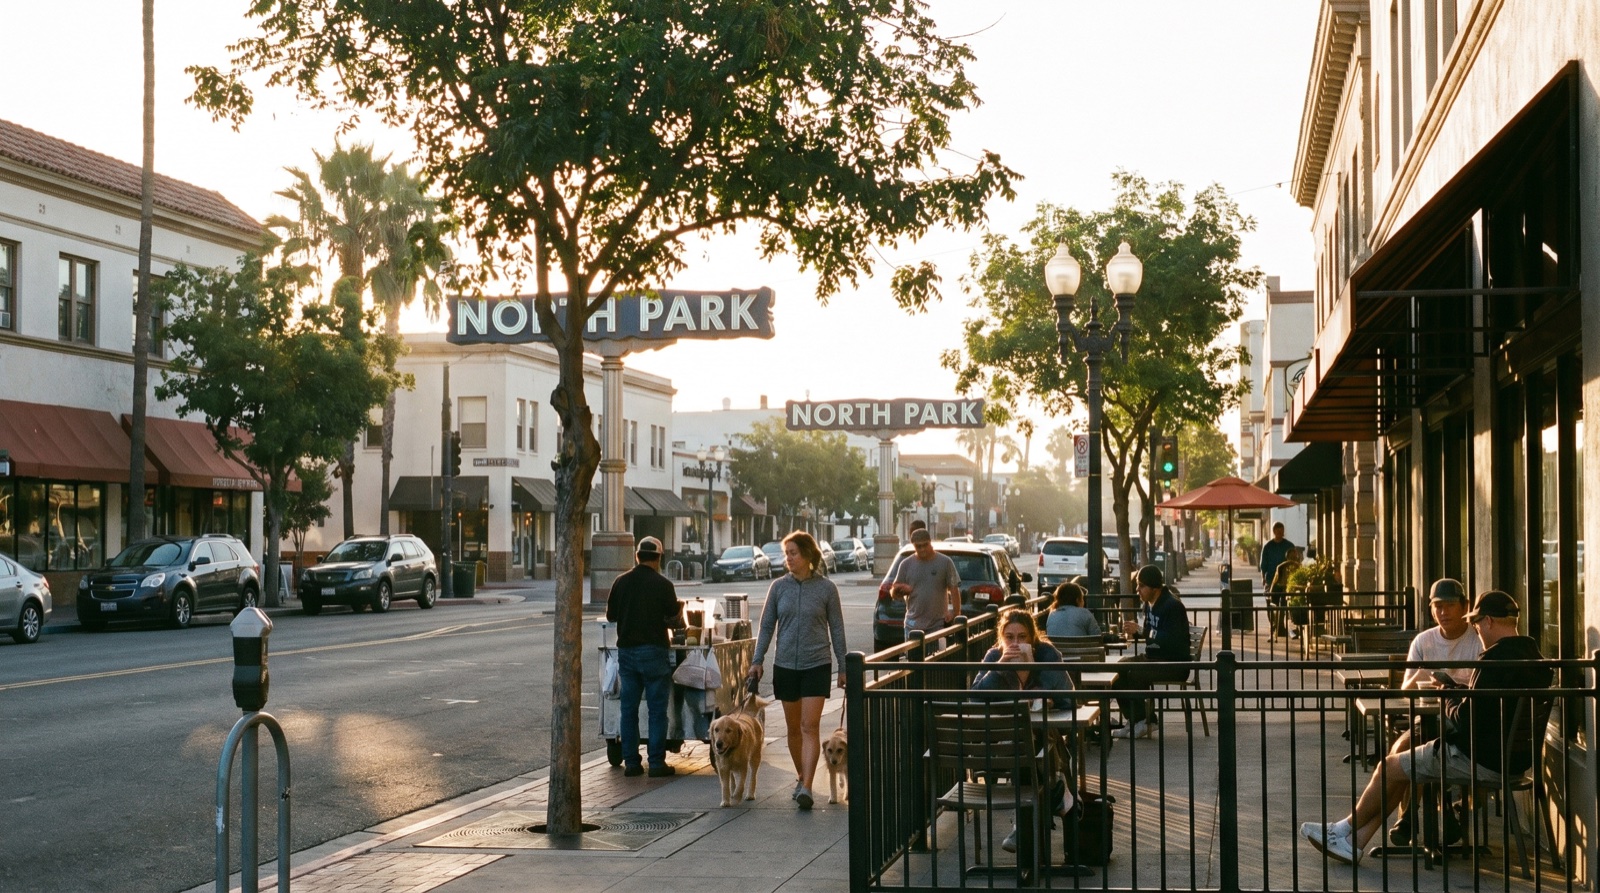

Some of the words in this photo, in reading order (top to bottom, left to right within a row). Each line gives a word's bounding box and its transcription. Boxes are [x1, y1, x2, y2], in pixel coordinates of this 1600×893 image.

[458, 297, 616, 335] NOH
[640, 294, 759, 332] PARK
[792, 402, 891, 426] NORTH
[904, 402, 979, 425] PARK
